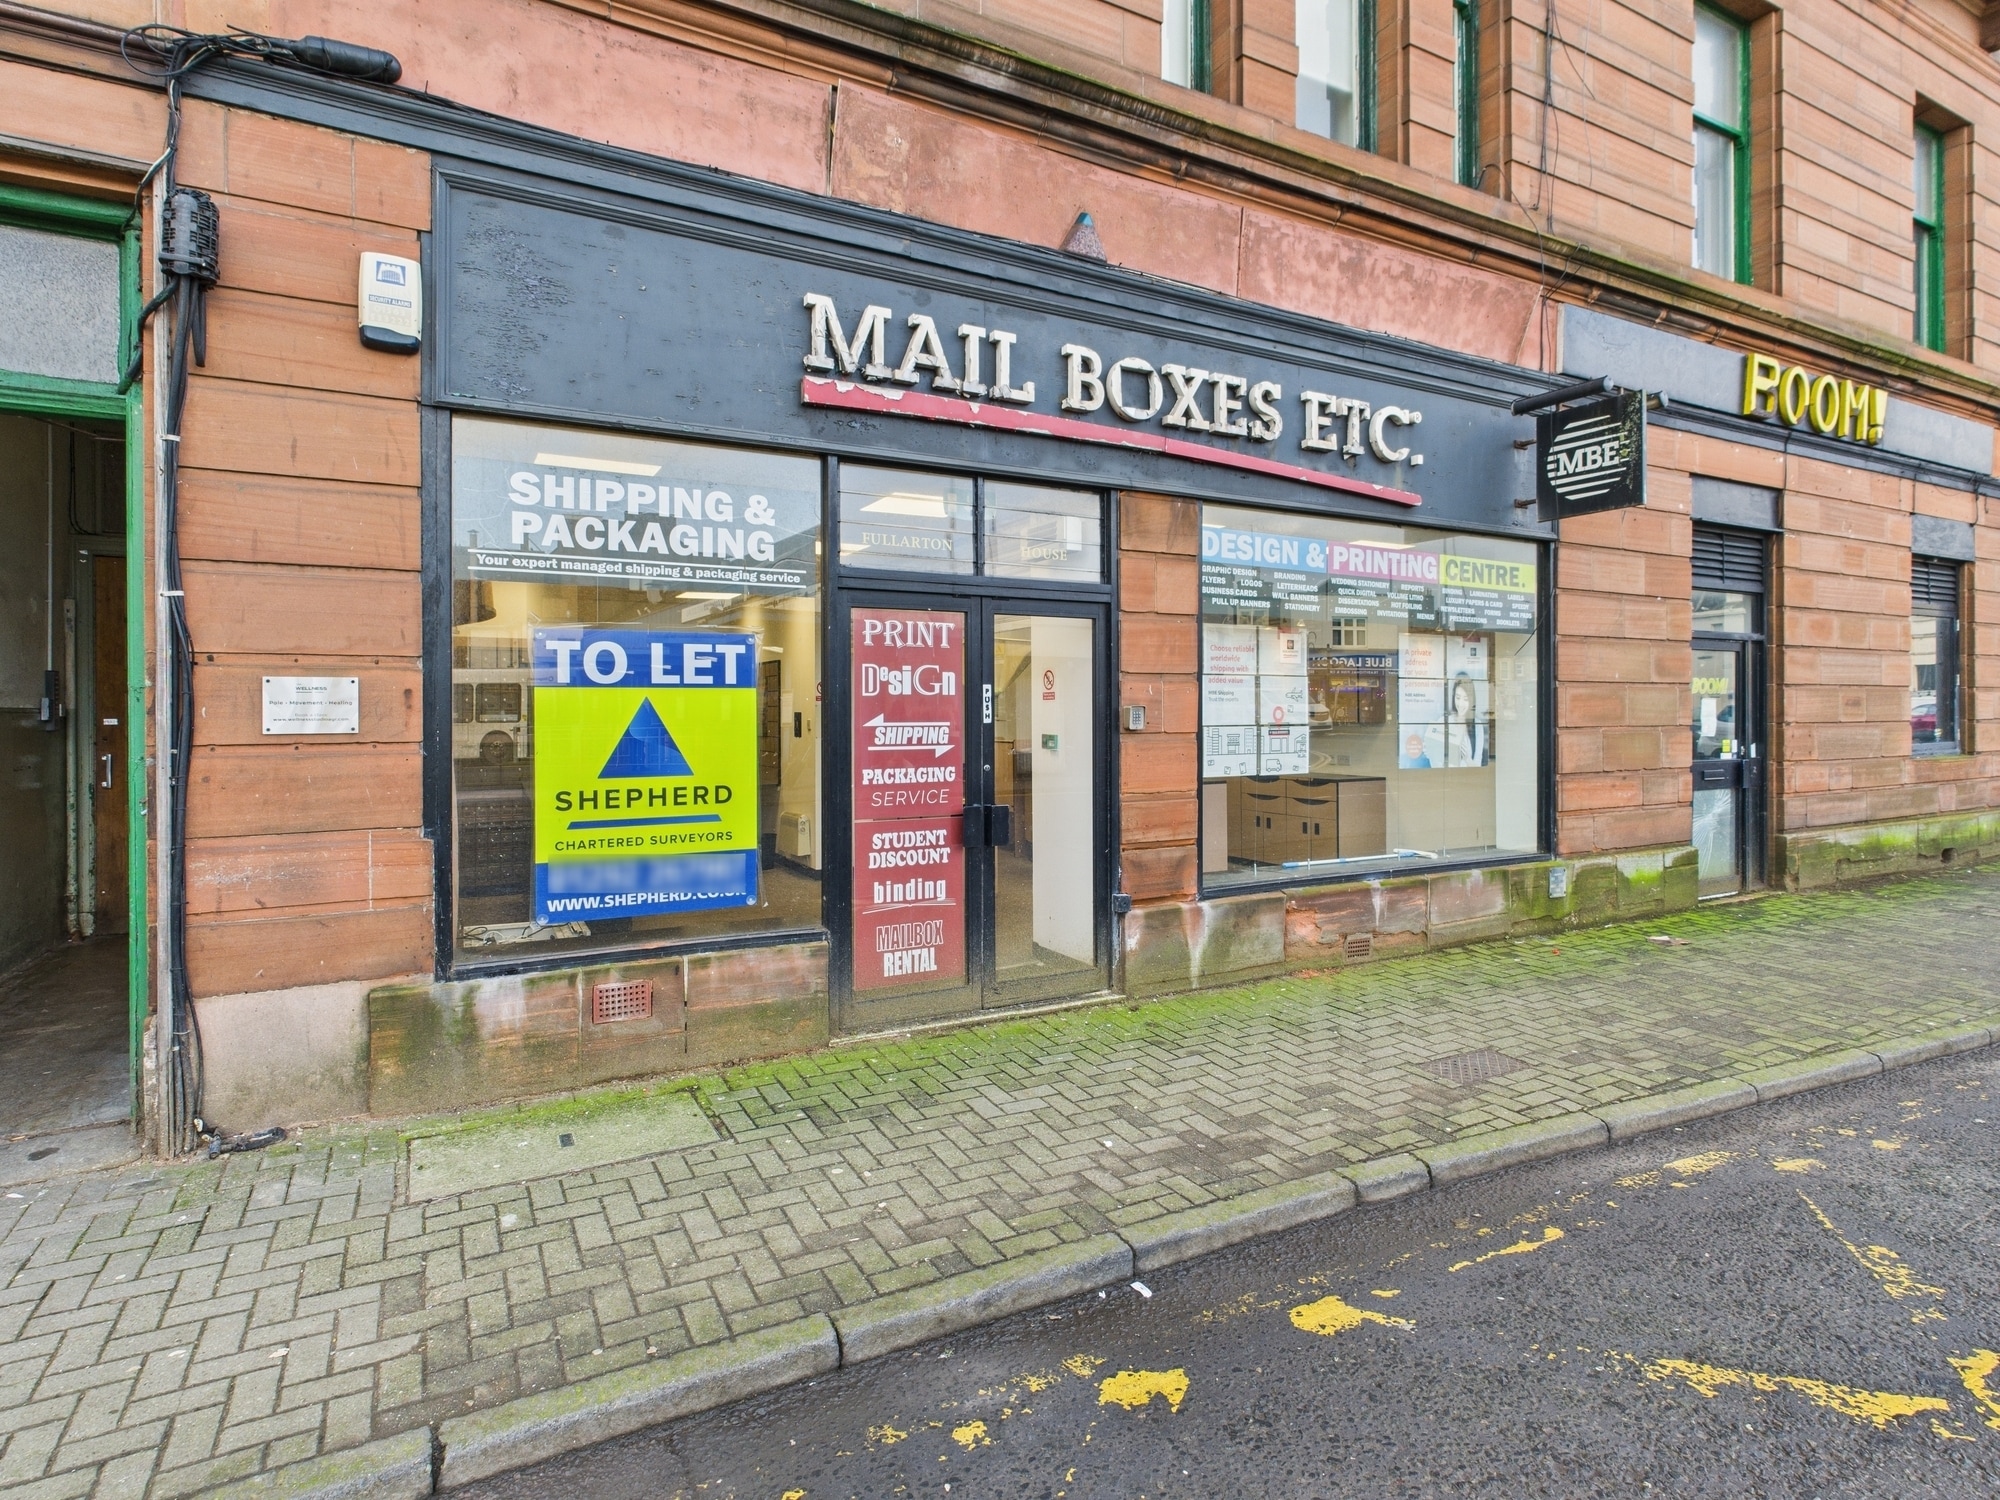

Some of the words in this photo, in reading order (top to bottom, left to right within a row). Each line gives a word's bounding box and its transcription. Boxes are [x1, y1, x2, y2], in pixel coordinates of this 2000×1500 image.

[803, 292, 1035, 405] MAIL
[1061, 343, 1283, 443] BOXES
[1301, 390, 1424, 467] ETC.
[1743, 353, 1889, 446] BOOM!
[1557, 441, 1620, 477] MBE
[508, 472, 733, 522] SHIPPING
[744, 494, 776, 527] &
[511, 511, 775, 562] PACKAGING
[862, 532, 953, 551] FULLARTON
[1021, 547, 1067, 561] HOUSE
[476, 554, 509, 566] Your
[512, 557, 558, 570] expert
[561, 562, 622, 574] managed
[625, 563, 681, 578] shipping
[683, 567, 693, 577] &
[695, 569, 758, 582] packaging
[759, 573, 800, 583] service
[1202, 531, 1298, 566] DESIGN
[1306, 542, 1325, 568] &
[1333, 548, 1437, 580] PRINTING
[1445, 559, 1526, 588] CENTRE.
[1202, 565, 1231, 574] GRAPHIC
[1274, 572, 1306, 581] BRANDING
[1202, 576, 1226, 584] FLYERS
[1241, 579, 1262, 587] LOGOS
[1277, 582, 1318, 592] LETTERHEADS
[1331, 578, 1357, 586] WEDDING
[1358, 580, 1390, 589] STATIONERY
[1401, 584, 1424, 592] REPORTS
[1202, 587, 1234, 595] BUSINESS
[1236, 589, 1257, 597] CARDS
[1290, 594, 1318, 602] BANNERS
[1338, 598, 1379, 607] DISSERTATIONS
[1387, 592, 1408, 600] VOLUME
[1240, 600, 1270, 608] BANNERS
[1285, 603, 1320, 612] STATIONERY
[1335, 607, 1367, 615] EMBOSSING
[1377, 610, 1408, 618] INVITATIONS
[1441, 606, 1475, 614] NEWSLETTERS
[1449, 616, 1487, 624] PRESENTATIONS
[863, 619, 955, 649] PRINT
[546, 640, 628, 684] TO
[651, 642, 745, 685] LET
[1411, 649, 1432, 657] private
[874, 726, 949, 746] SHIPPING
[862, 766, 956, 785] PACKAGING
[555, 785, 733, 812] SHEPHERD
[871, 788, 949, 807] SERVICE
[554, 836, 645, 851] CHARTERED
[650, 831, 733, 846] SURVEYORS
[872, 829, 947, 850] STUDENT
[868, 847, 950, 870] DISCOUNT
[874, 878, 946, 904] binding
[547, 892, 747, 912] WWW.SHEPHERD.C.
[876, 920, 944, 953] MAILBOX
[883, 947, 937, 977] RENTAL
